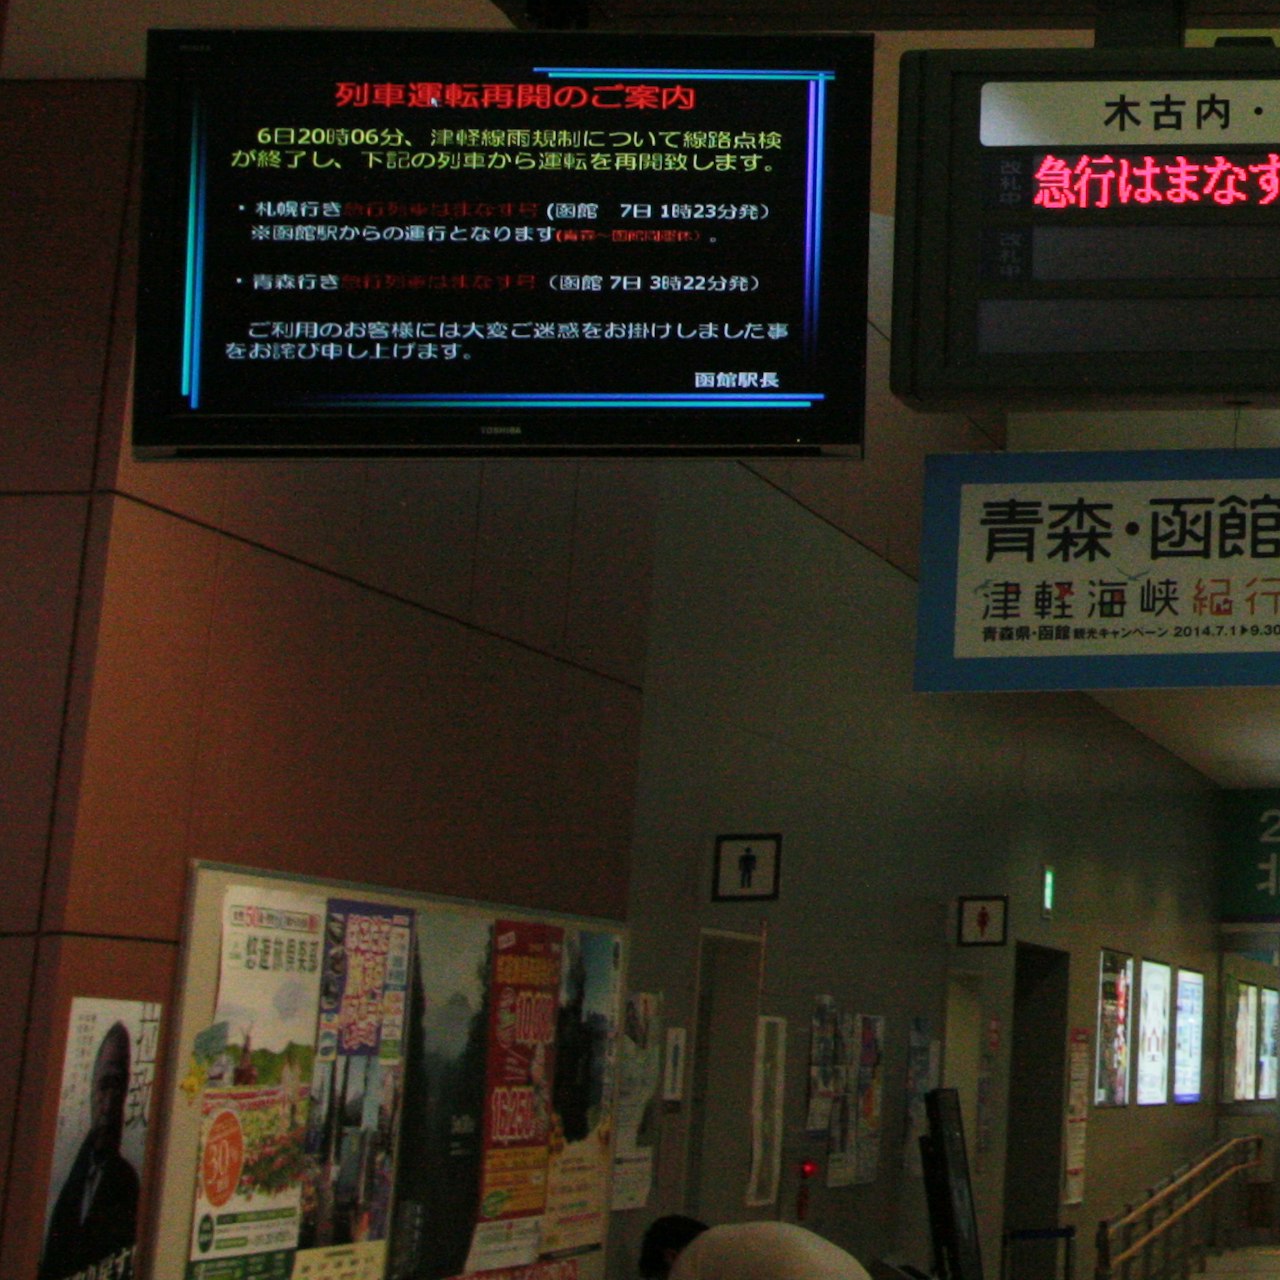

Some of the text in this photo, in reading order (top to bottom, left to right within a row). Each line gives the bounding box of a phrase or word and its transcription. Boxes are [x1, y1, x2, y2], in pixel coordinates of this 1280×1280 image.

[334, 82, 696, 111] 列車運転再開のご案内
[248, 322, 788, 342] ご利用のお客様には大変ご迷惑をお掛けしました事
[226, 341, 472, 361] をお詫び申し上げます。
[693, 371, 780, 389] 函館駅長
[982, 625, 1070, 642] 青森県・函館
